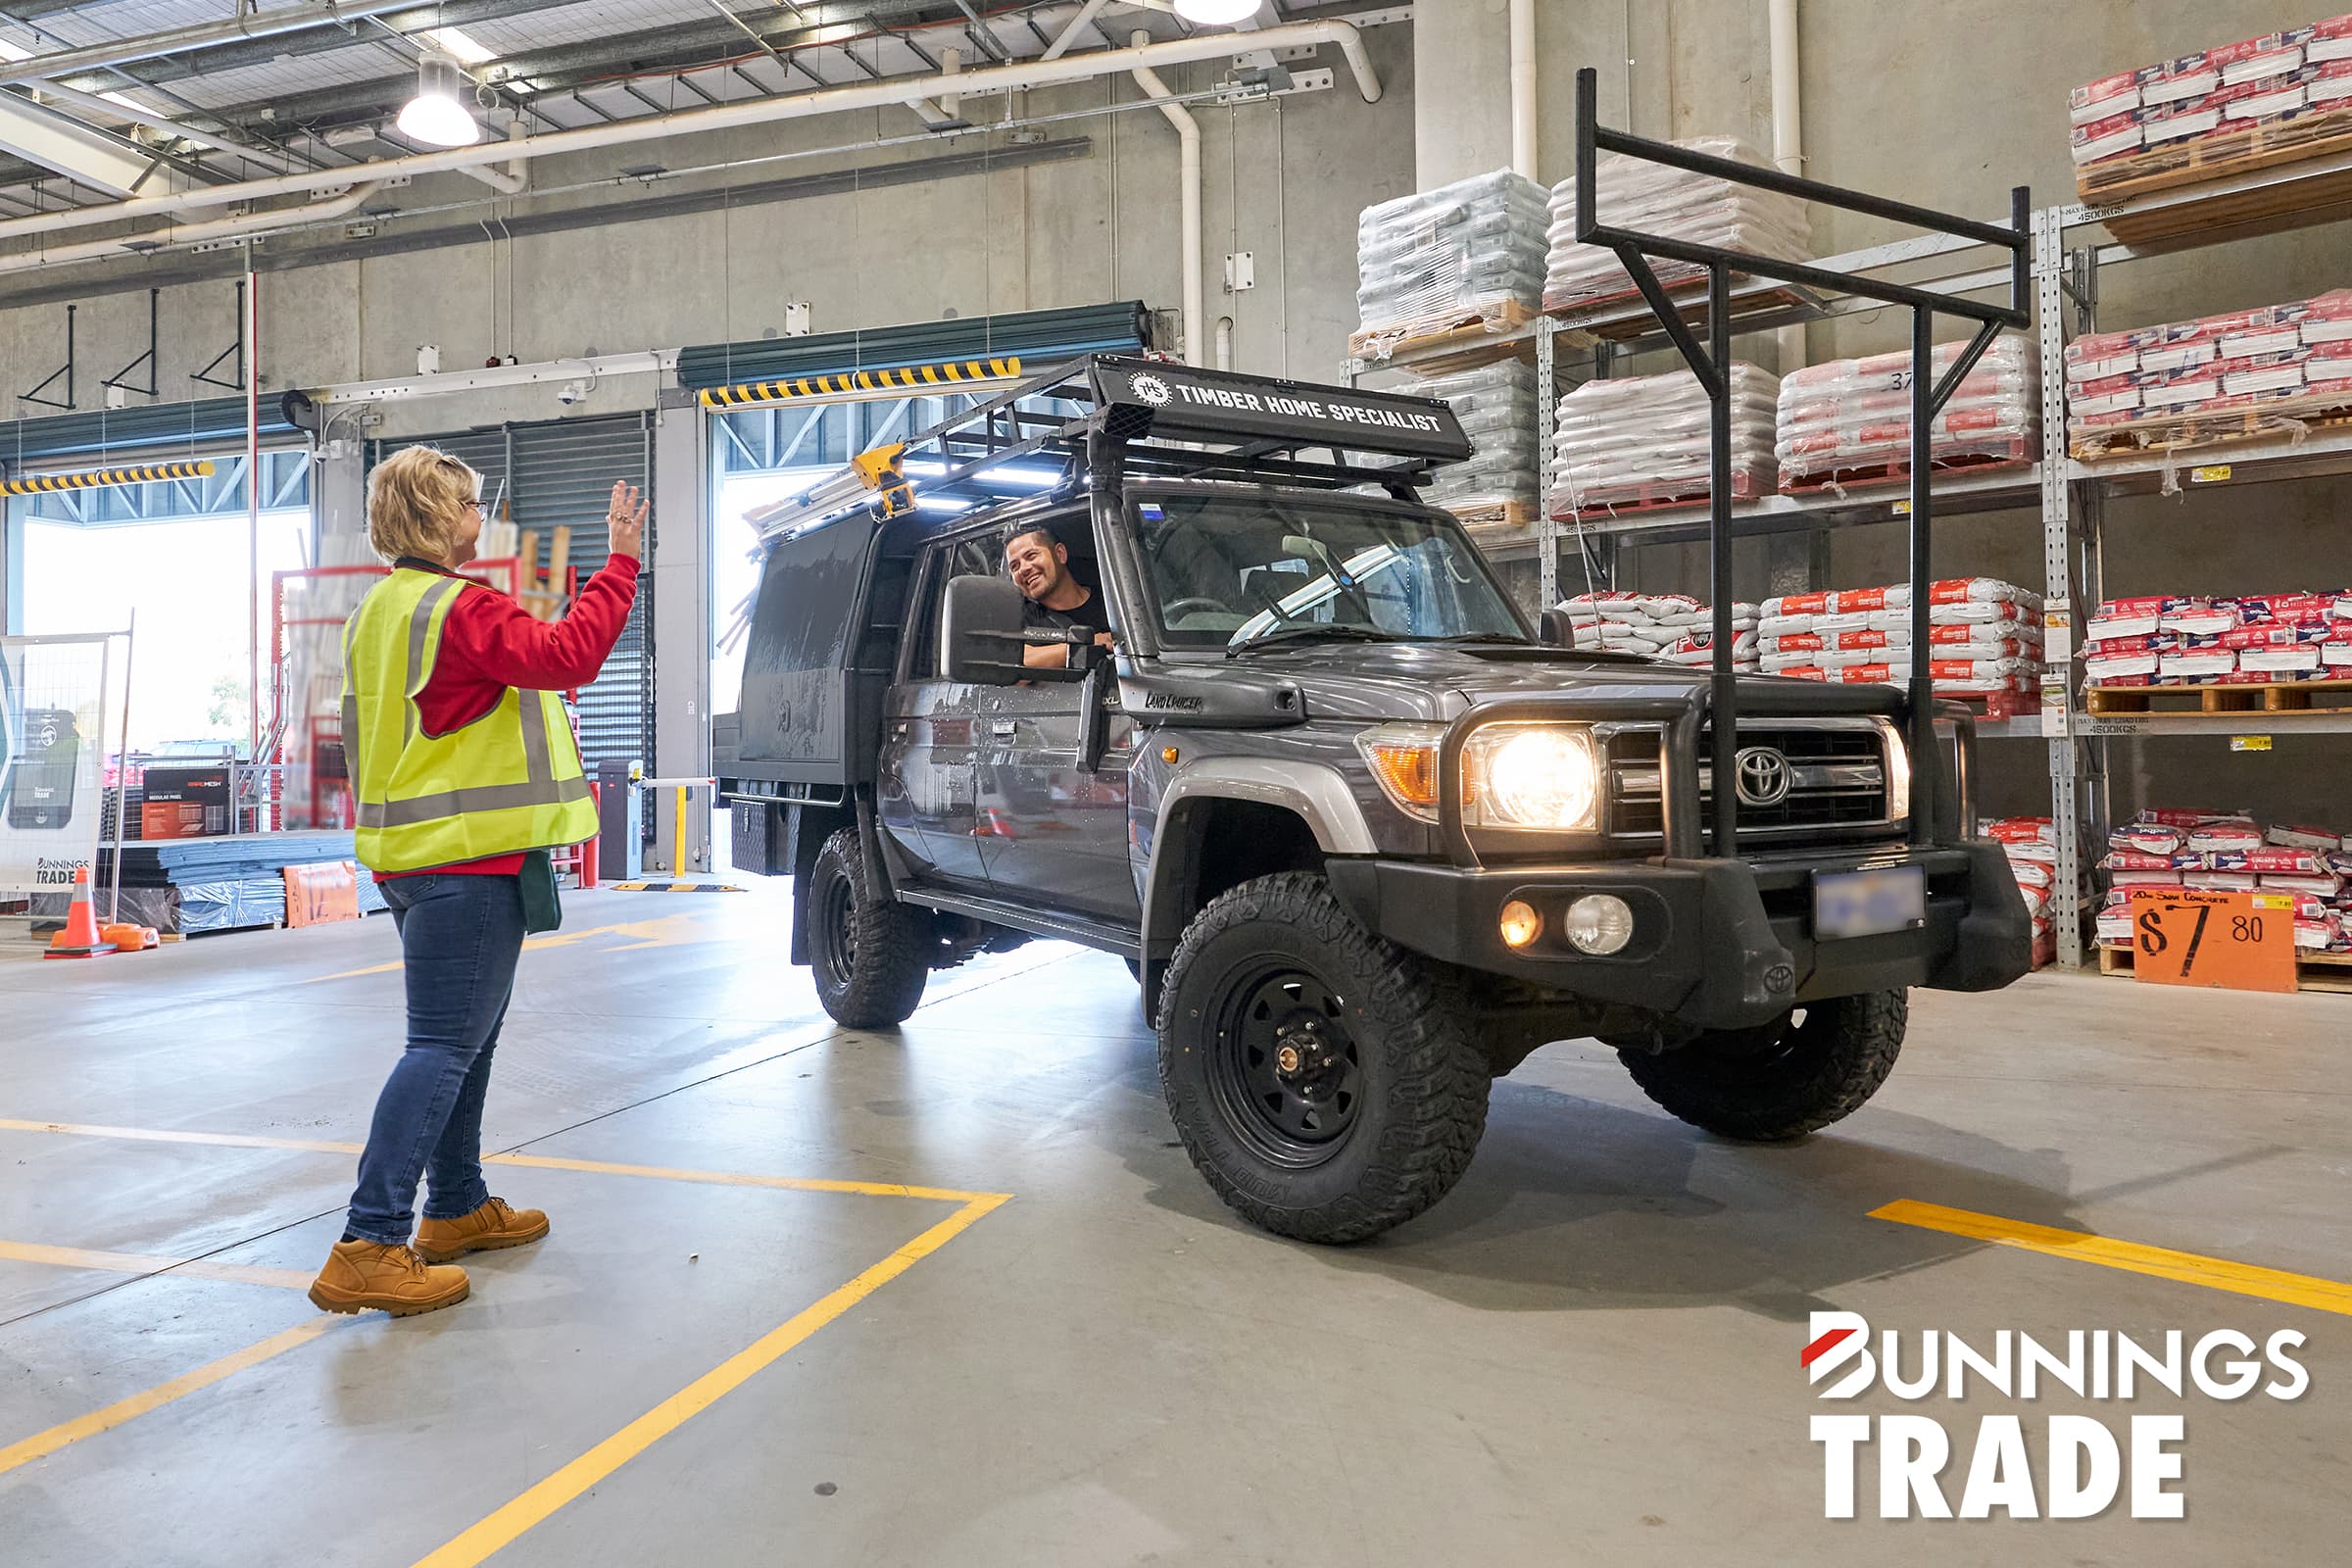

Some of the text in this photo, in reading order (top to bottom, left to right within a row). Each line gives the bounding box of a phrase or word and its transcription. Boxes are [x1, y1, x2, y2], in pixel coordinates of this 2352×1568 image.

[1175, 384, 1264, 412] TIMBER
[1263, 396, 1327, 419] HOME
[1327, 404, 1442, 432] SPECIALIST
[36, 871, 75, 884] TRADE
[2231, 915, 2263, 942] 80
